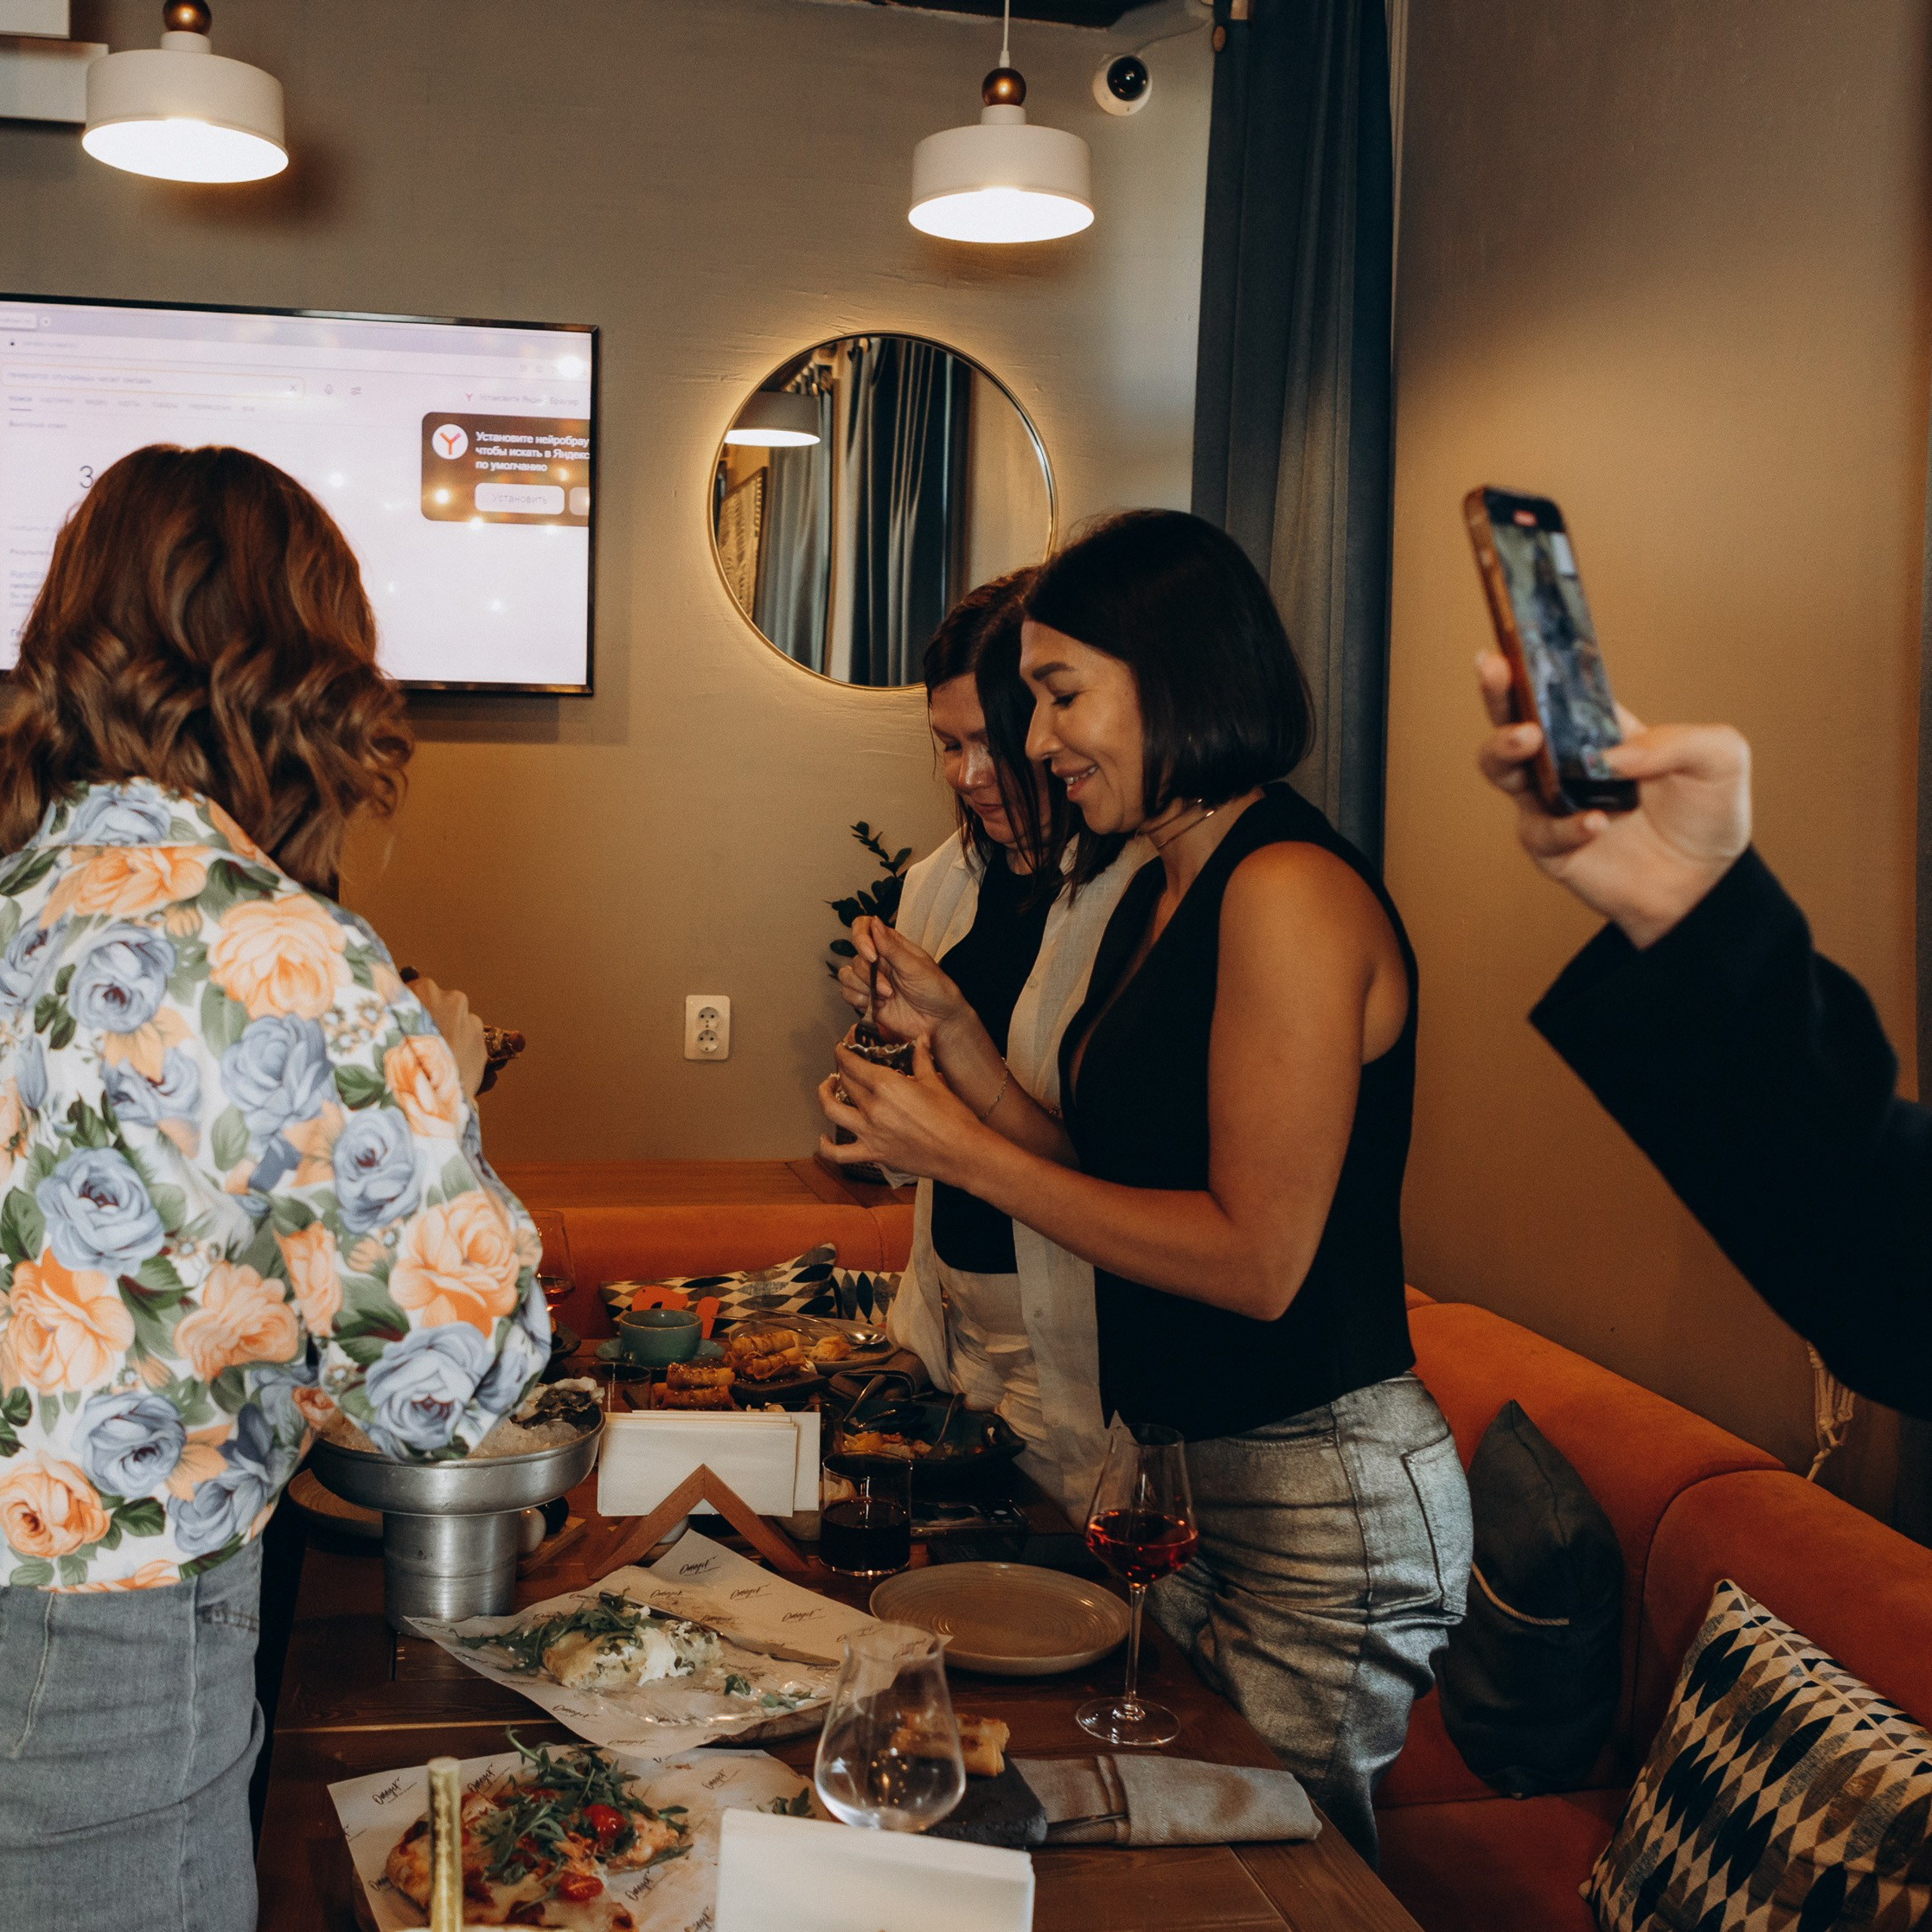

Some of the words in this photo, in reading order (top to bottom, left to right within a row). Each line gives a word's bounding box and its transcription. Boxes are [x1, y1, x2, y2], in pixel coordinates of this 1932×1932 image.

[475, 432, 534, 444] Установите
[475, 446, 508, 456] чтобы
[509, 449, 543, 458] искать
[475, 460, 489, 469] по
[491, 461, 548, 472] умолчанию
[492, 494, 549, 504] Установить
